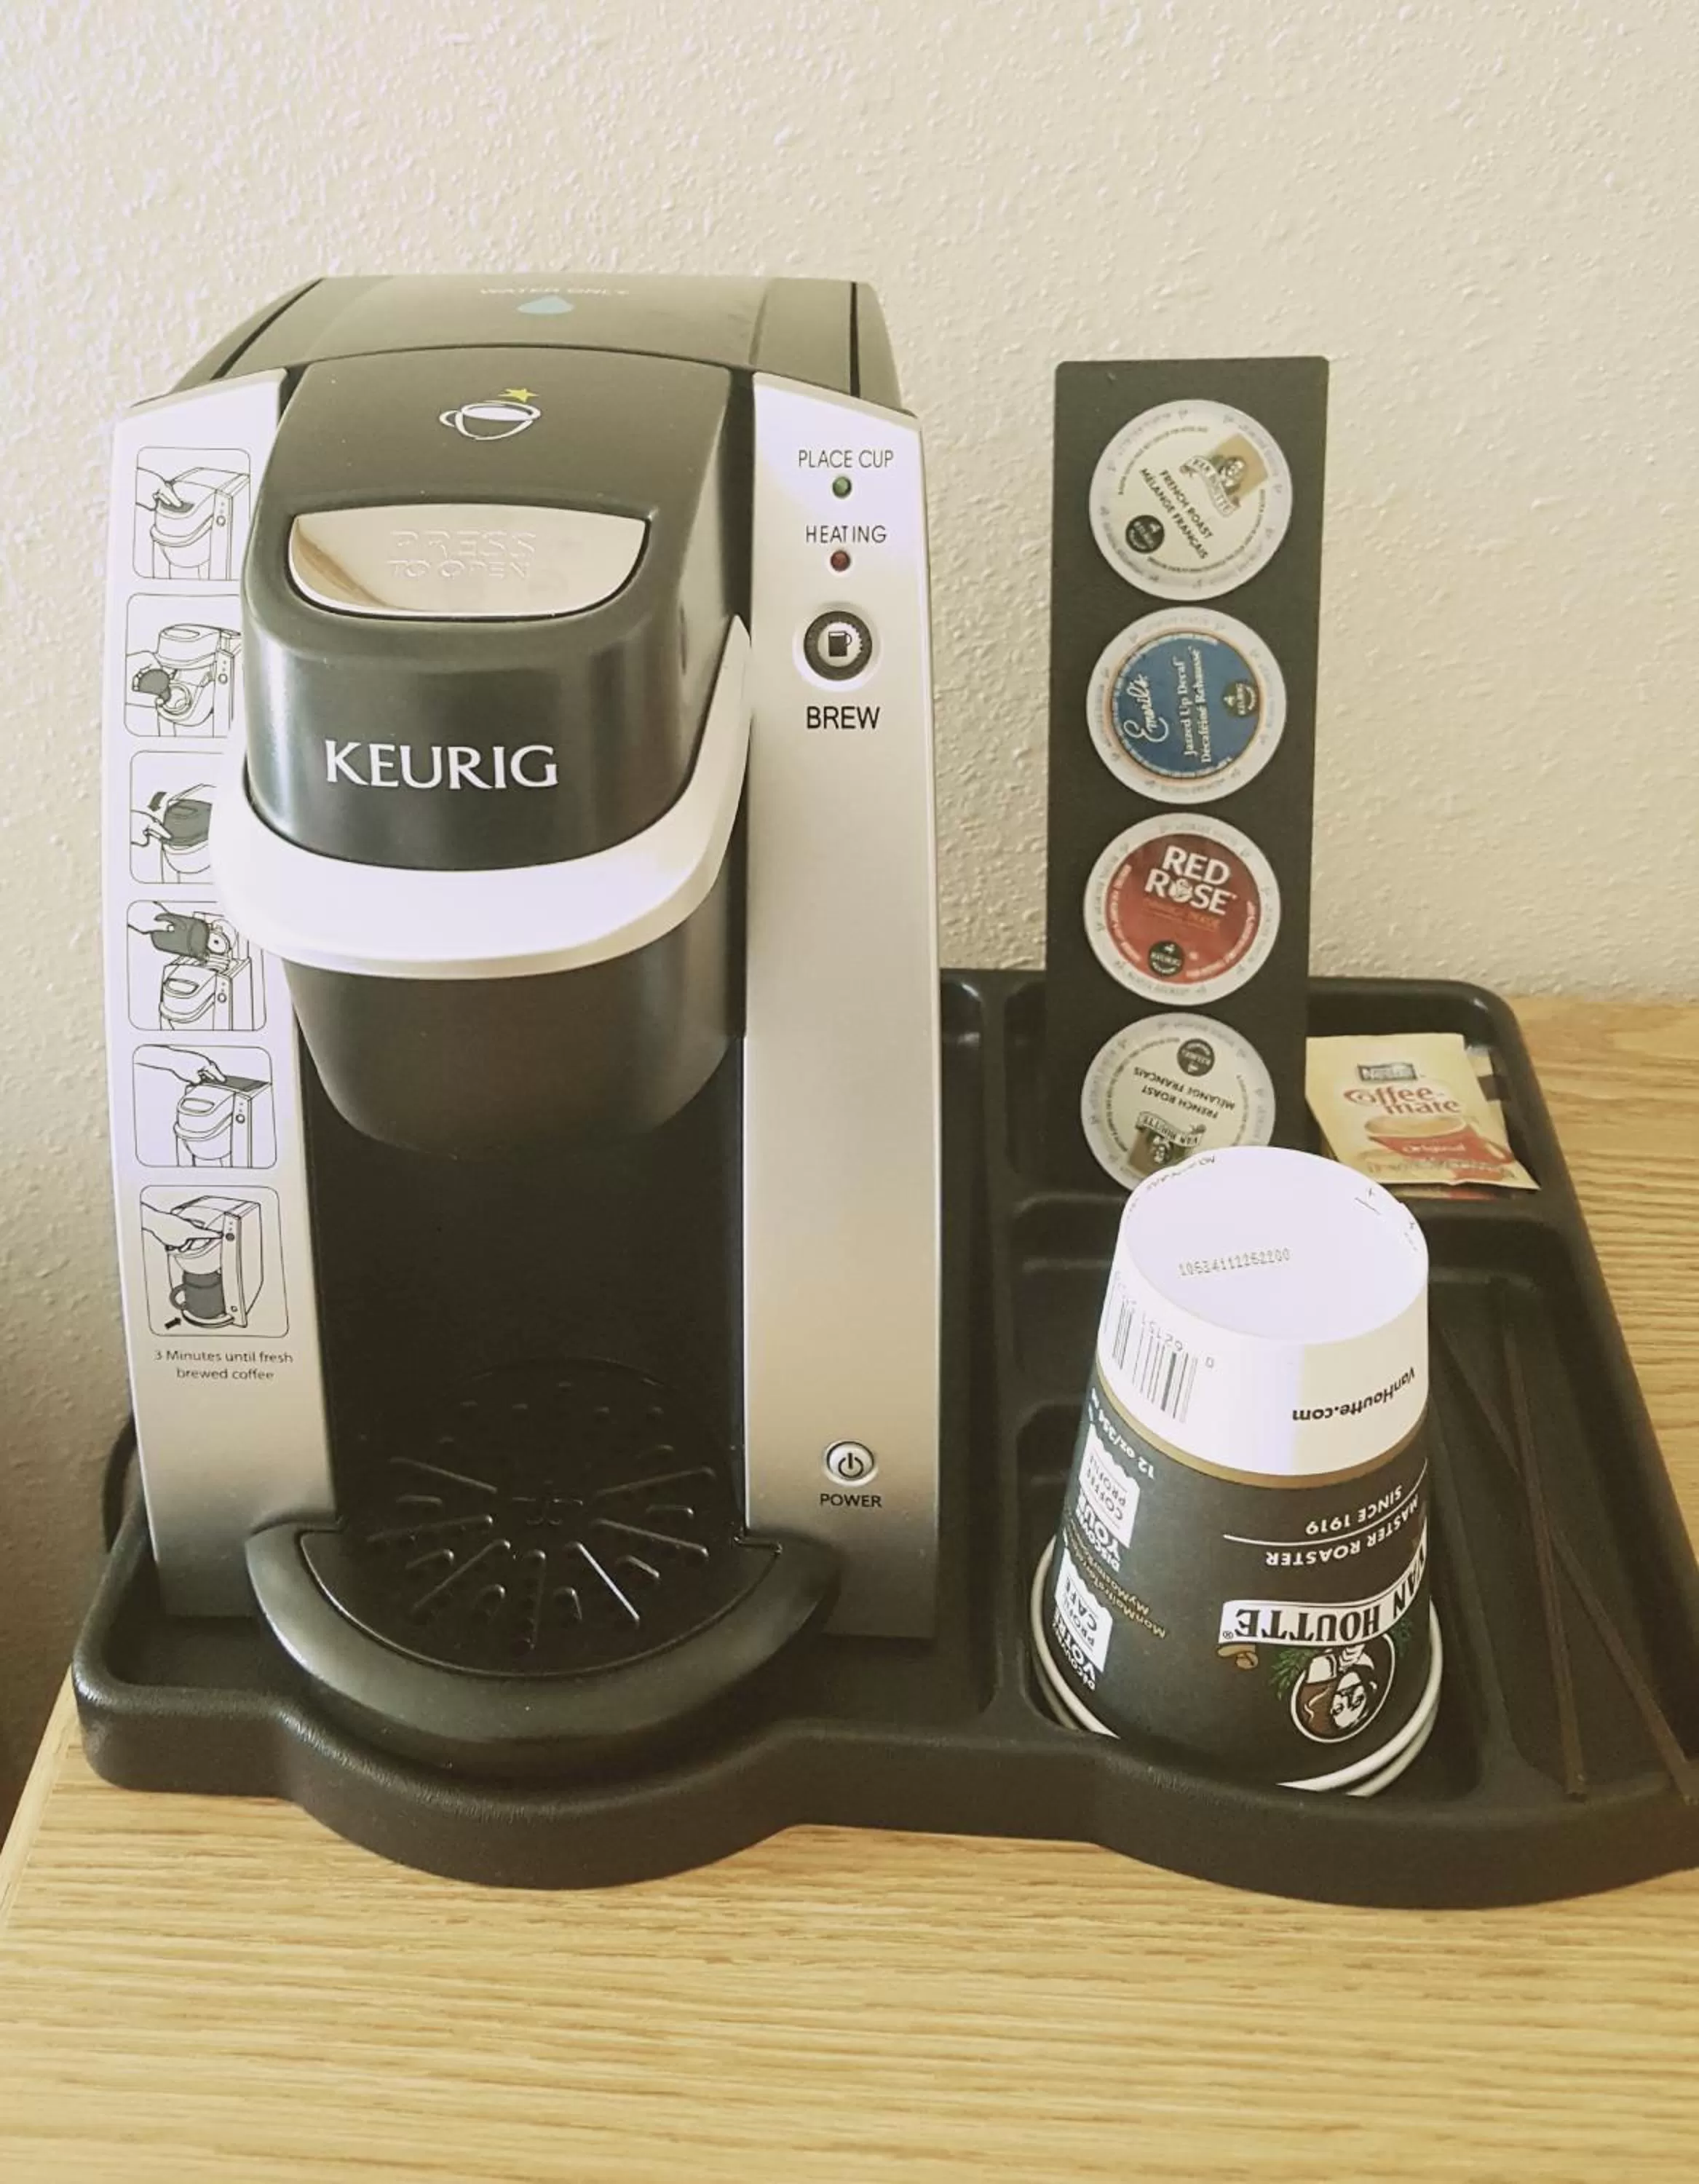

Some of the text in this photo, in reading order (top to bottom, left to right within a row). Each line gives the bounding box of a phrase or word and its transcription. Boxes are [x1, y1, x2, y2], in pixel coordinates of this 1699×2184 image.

[799, 449, 894, 468] PLACE CUP
[1159, 470, 1189, 509] FRENCH
[1187, 507, 1214, 540] ROAST
[389, 529, 537, 558] PRESS
[805, 525, 887, 543] HEATING
[387, 559, 531, 579] TO OPEN
[807, 706, 880, 729] BREW
[1179, 696, 1193, 716] Up
[1179, 719, 1199, 757] Jazzed
[325, 739, 559, 790] KEURIG
[1161, 844, 1231, 885] RED
[1144, 868, 1232, 916] ROSE
[1141, 1084, 1220, 1119] FRENCH ROAST
[1385, 1099, 1462, 1115] mate
[154, 1350, 294, 1364] 3 Minutes until fresh
[176, 1367, 275, 1380] brewed coffee
[1291, 1366, 1415, 1420] VanHoutte.com
[1138, 1457, 1155, 1480] 12
[820, 1493, 883, 1508] POWER
[1305, 1485, 1402, 1535] SINCE 1919
[1265, 1493, 1419, 1566] MASTER ROASTER
[1234, 1604, 1382, 1642] HOUTTE
